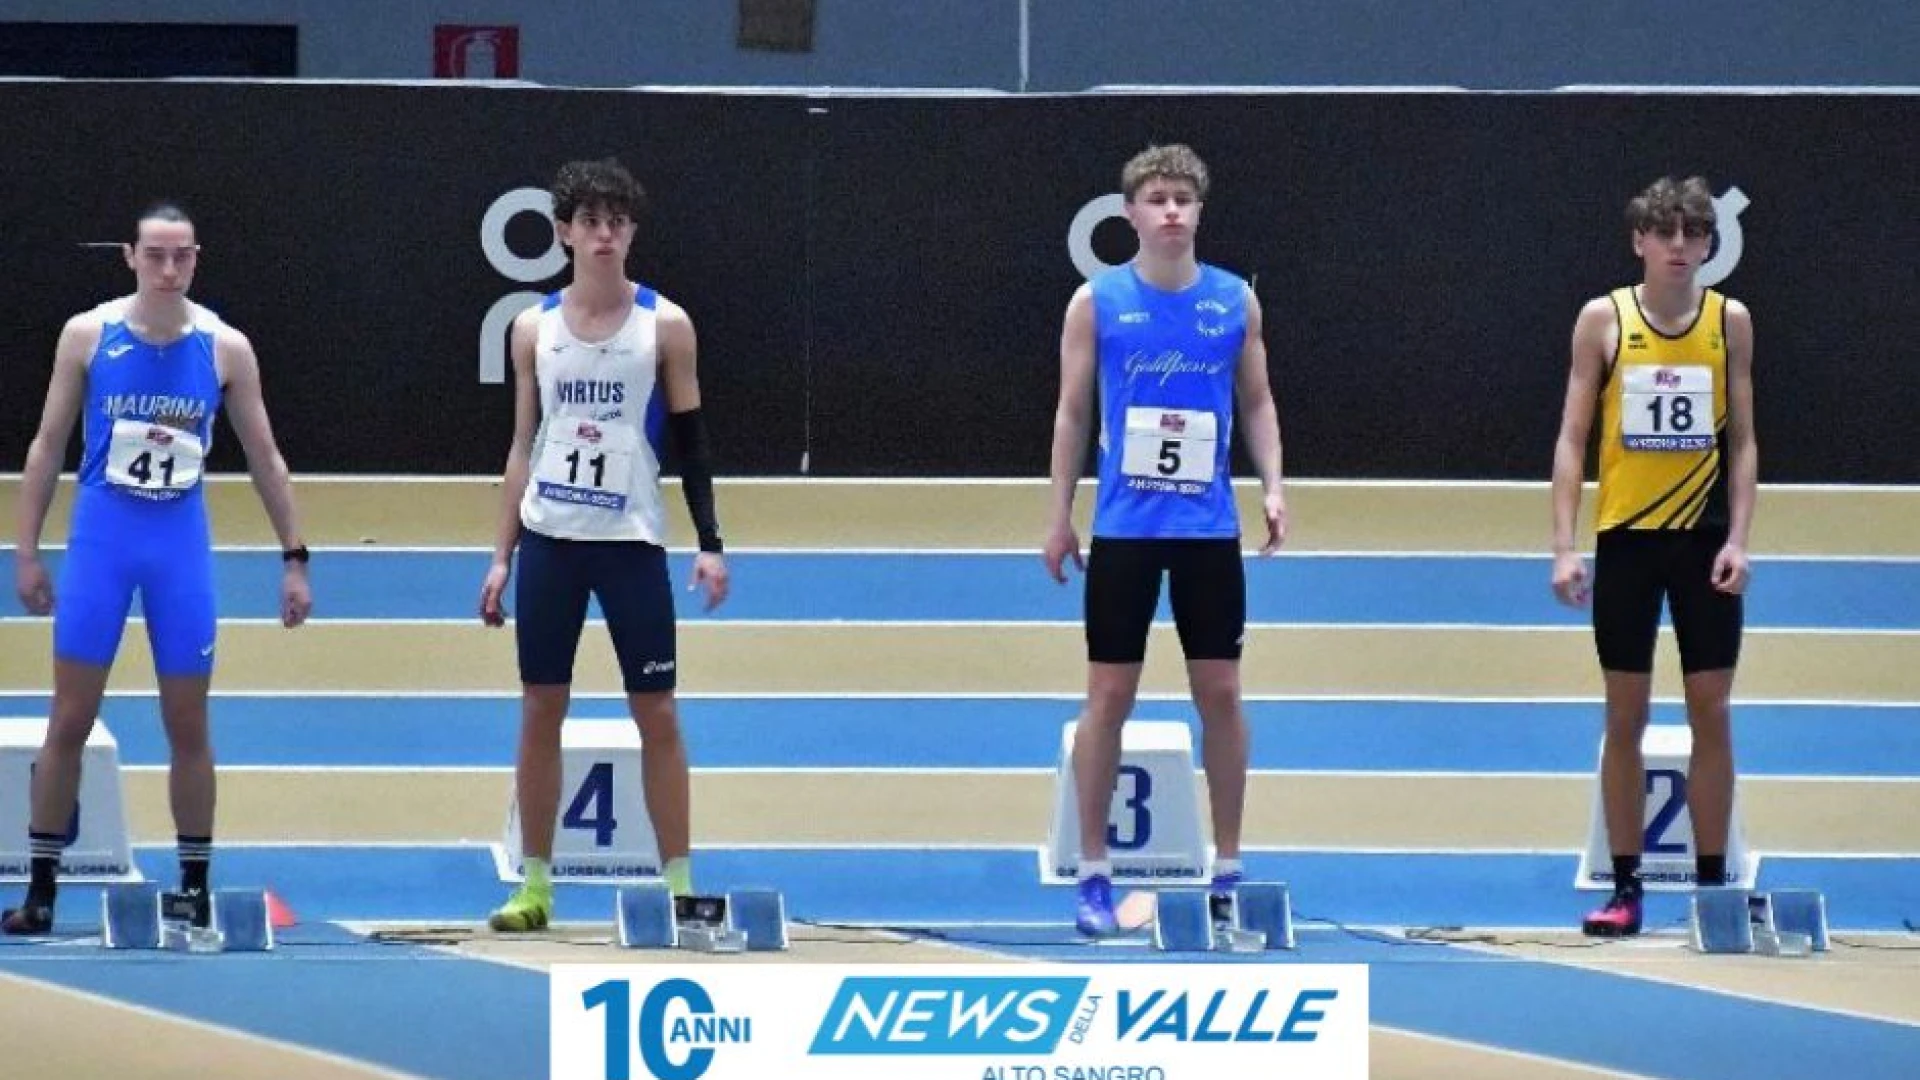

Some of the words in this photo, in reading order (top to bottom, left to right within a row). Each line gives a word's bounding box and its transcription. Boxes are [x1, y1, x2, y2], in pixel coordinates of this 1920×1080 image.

[557, 380, 625, 403] VIRTUS
[1647, 395, 1694, 432] 18
[128, 451, 175, 486] 41
[565, 449, 607, 487] 11
[1157, 441, 1182, 475] 5
[562, 763, 617, 847] 4
[1107, 765, 1152, 851] 3
[1643, 769, 1689, 853] 2
